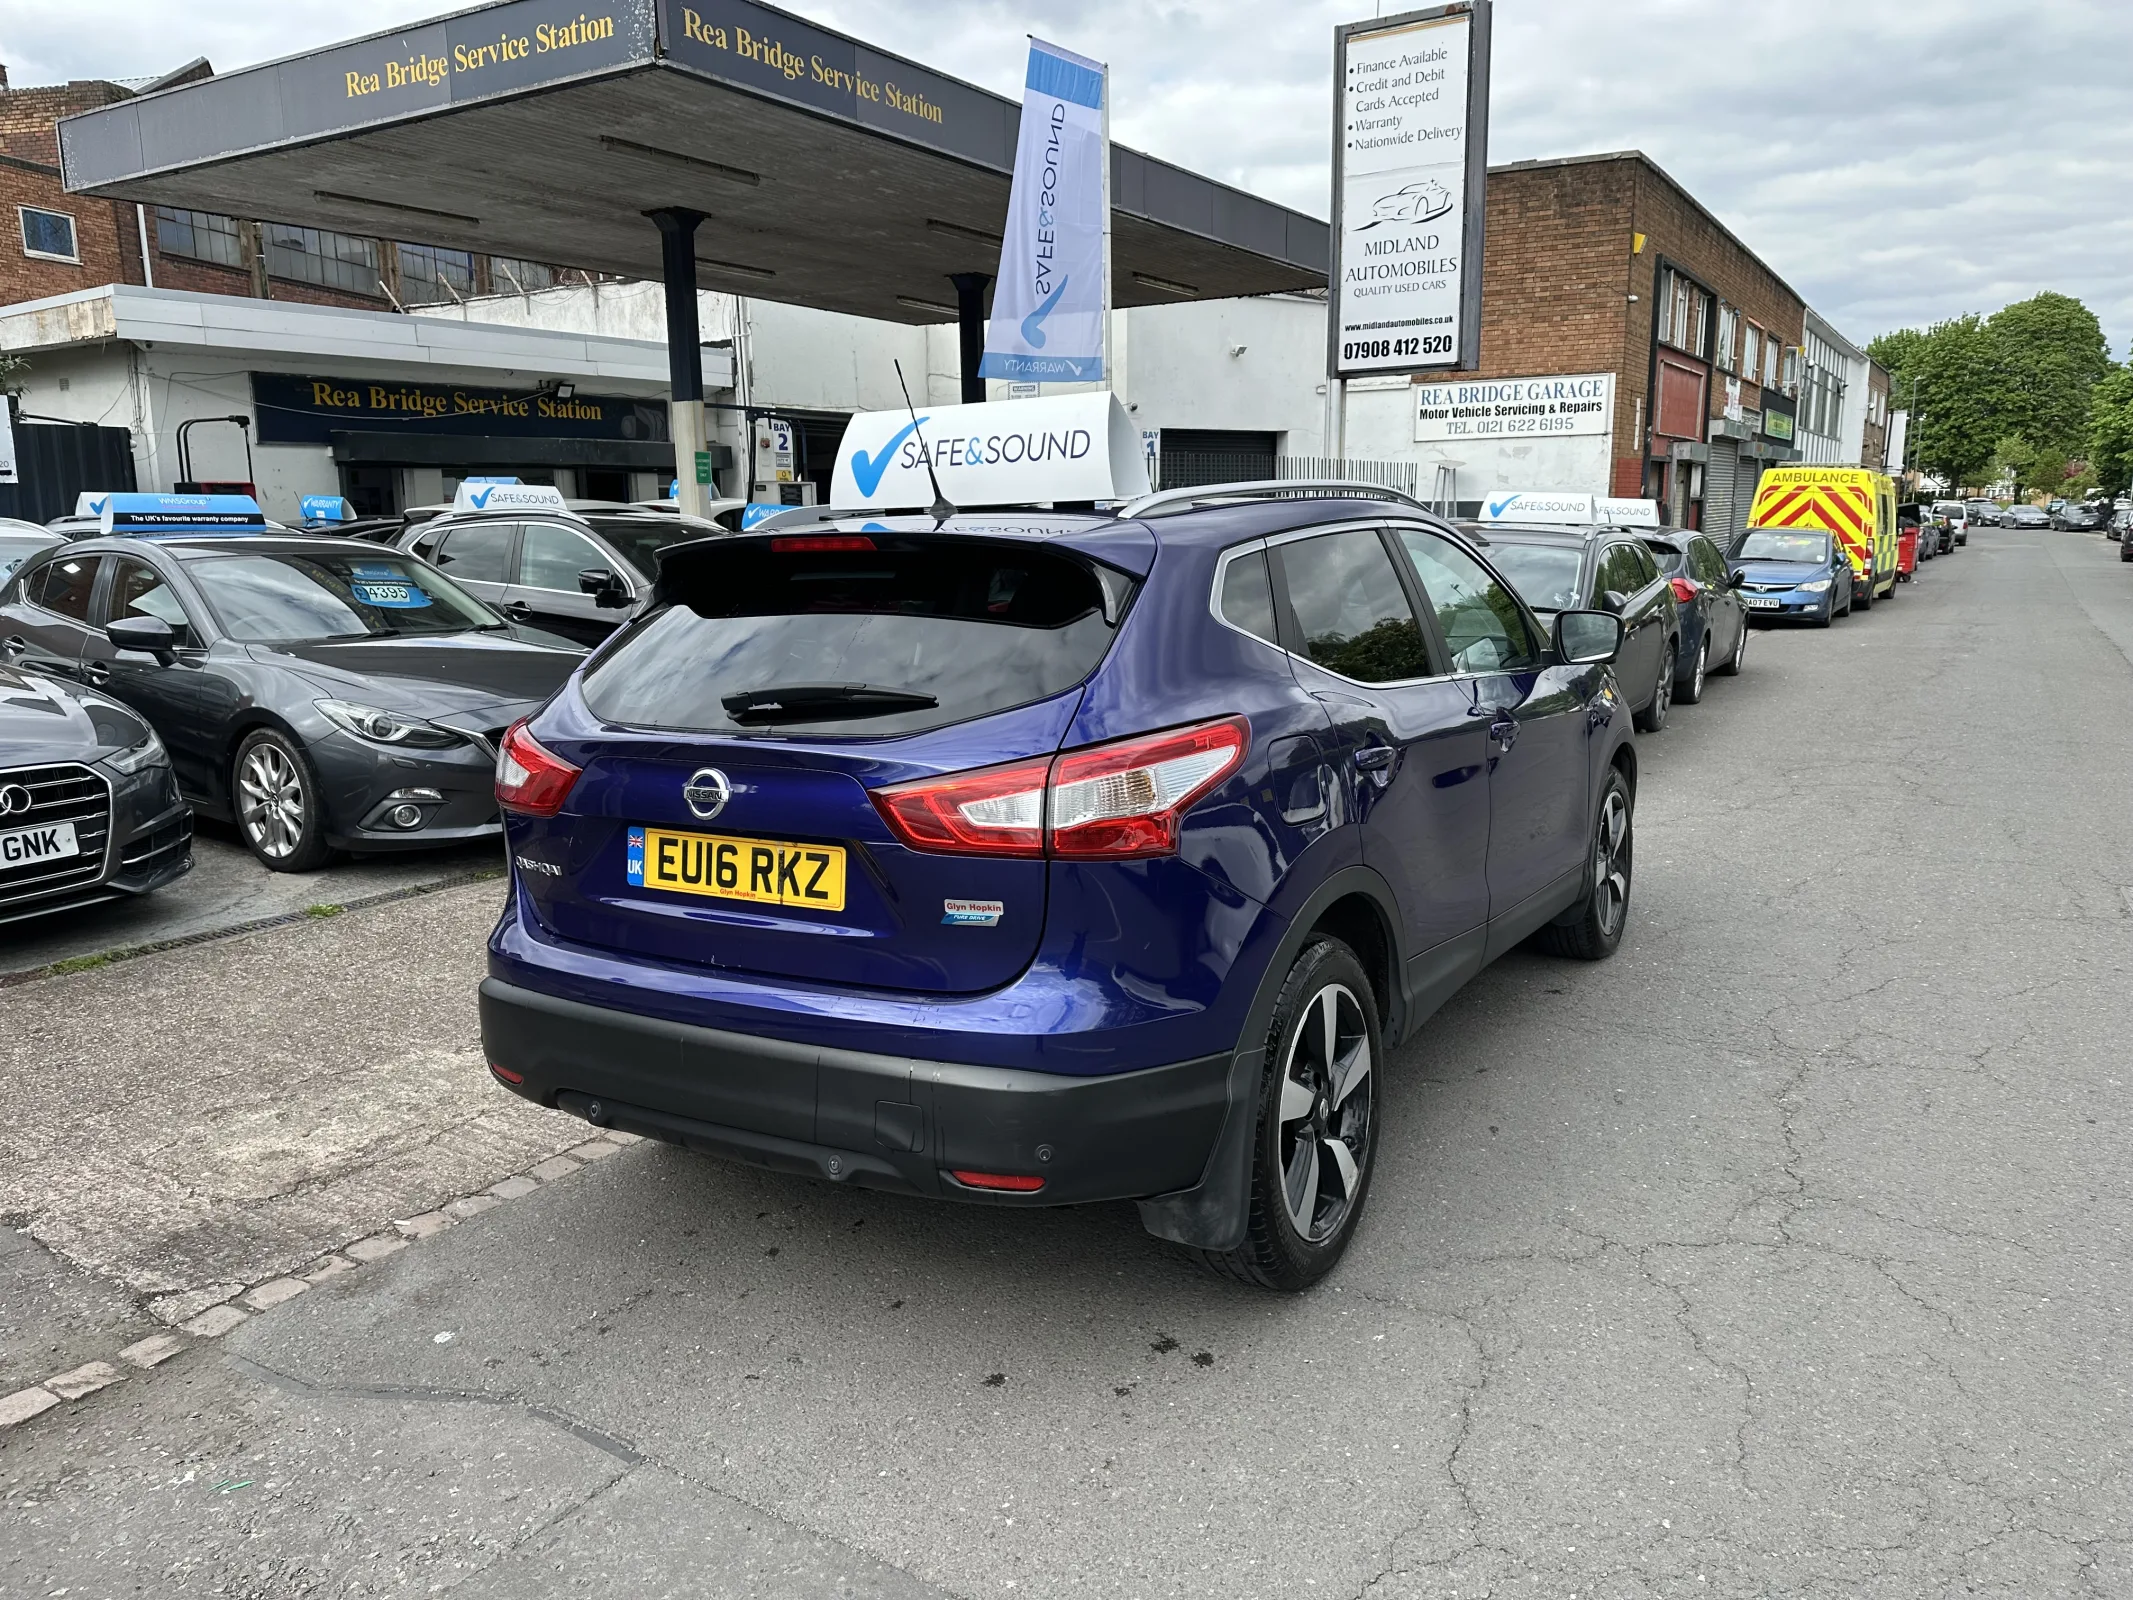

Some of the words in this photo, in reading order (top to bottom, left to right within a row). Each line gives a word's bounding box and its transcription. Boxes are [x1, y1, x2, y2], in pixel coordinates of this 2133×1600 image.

[345, 70, 380, 98] Rea
[385, 54, 448, 87] Bridge
[454, 34, 529, 73] Service
[536, 13, 614, 54] Station
[1357, 59, 1396, 75] Finance
[1399, 47, 1448, 68] Available
[682, 7, 728, 50] Rea
[735, 26, 805, 81] Bridge
[811, 55, 880, 102] Service
[885, 81, 943, 124] Station
[1356, 77, 1389, 93] Credit
[1391, 73, 1411, 88] and
[1415, 68, 1445, 84] Debit
[1356, 97, 1386, 113] Cards
[1388, 87, 1439, 108] Accepted
[1355, 115, 1402, 132] Warranty
[1355, 131, 1414, 151] Nationwide
[1417, 126, 1463, 141] Delivery
[1364, 234, 1440, 257] MIDLAND
[1345, 257, 1458, 283] AUTOMOBILES
[1353, 284, 1393, 298] QUALITY
[1394, 282, 1420, 293] USED
[1422, 280, 1447, 291] CARS
[1345, 315, 1454, 332] www.midlandautomobiles.co.uk
[1344, 339, 1390, 360] 07908
[1393, 337, 1419, 356] 412
[1423, 335, 1452, 354] 520
[310, 382, 361, 408] Rea
[368, 386, 448, 418] Bridge
[454, 391, 529, 416] Service
[537, 396, 603, 420] Station
[1420, 389, 1453, 406] REA
[1458, 383, 1524, 404] BRIDGE
[1527, 379, 1603, 400] GARAGE
[1419, 407, 1449, 420] Motor
[1452, 405, 1492, 418] Vehicle
[1494, 403, 1545, 417] Servicing
[1548, 404, 1556, 414] &
[1560, 401, 1602, 415] Repairs
[773, 423, 790, 432] BAY
[1446, 422, 1474, 434] TEL.
[1477, 420, 1504, 433] 0121
[1507, 418, 1536, 432] 622
[1539, 417, 1574, 431] 6195
[778, 433, 789, 451] 2
[1142, 431, 1159, 439] BAY
[900, 429, 1091, 469] SAFE&SOUND
[1146, 440, 1155, 457] 1
[1772, 472, 1859, 484] AMBULANCE
[310, 499, 340, 509] WARRANTY
[491, 493, 559, 505] SAFE&SOUND
[1510, 500, 1586, 512] SAFE&SOUND
[1597, 506, 1651, 516] FE&SOUND
[687, 791, 723, 800] NISSAN
[2, 829, 61, 861] GNK
[628, 858, 643, 875] UK
[657, 837, 738, 889] EU16
[750, 848, 830, 900] RKZ
[719, 887, 734, 898] Glyn
[735, 889, 756, 899] Hopkin
[946, 902, 967, 912] Glyn
[969, 903, 1002, 912] Hopkin
